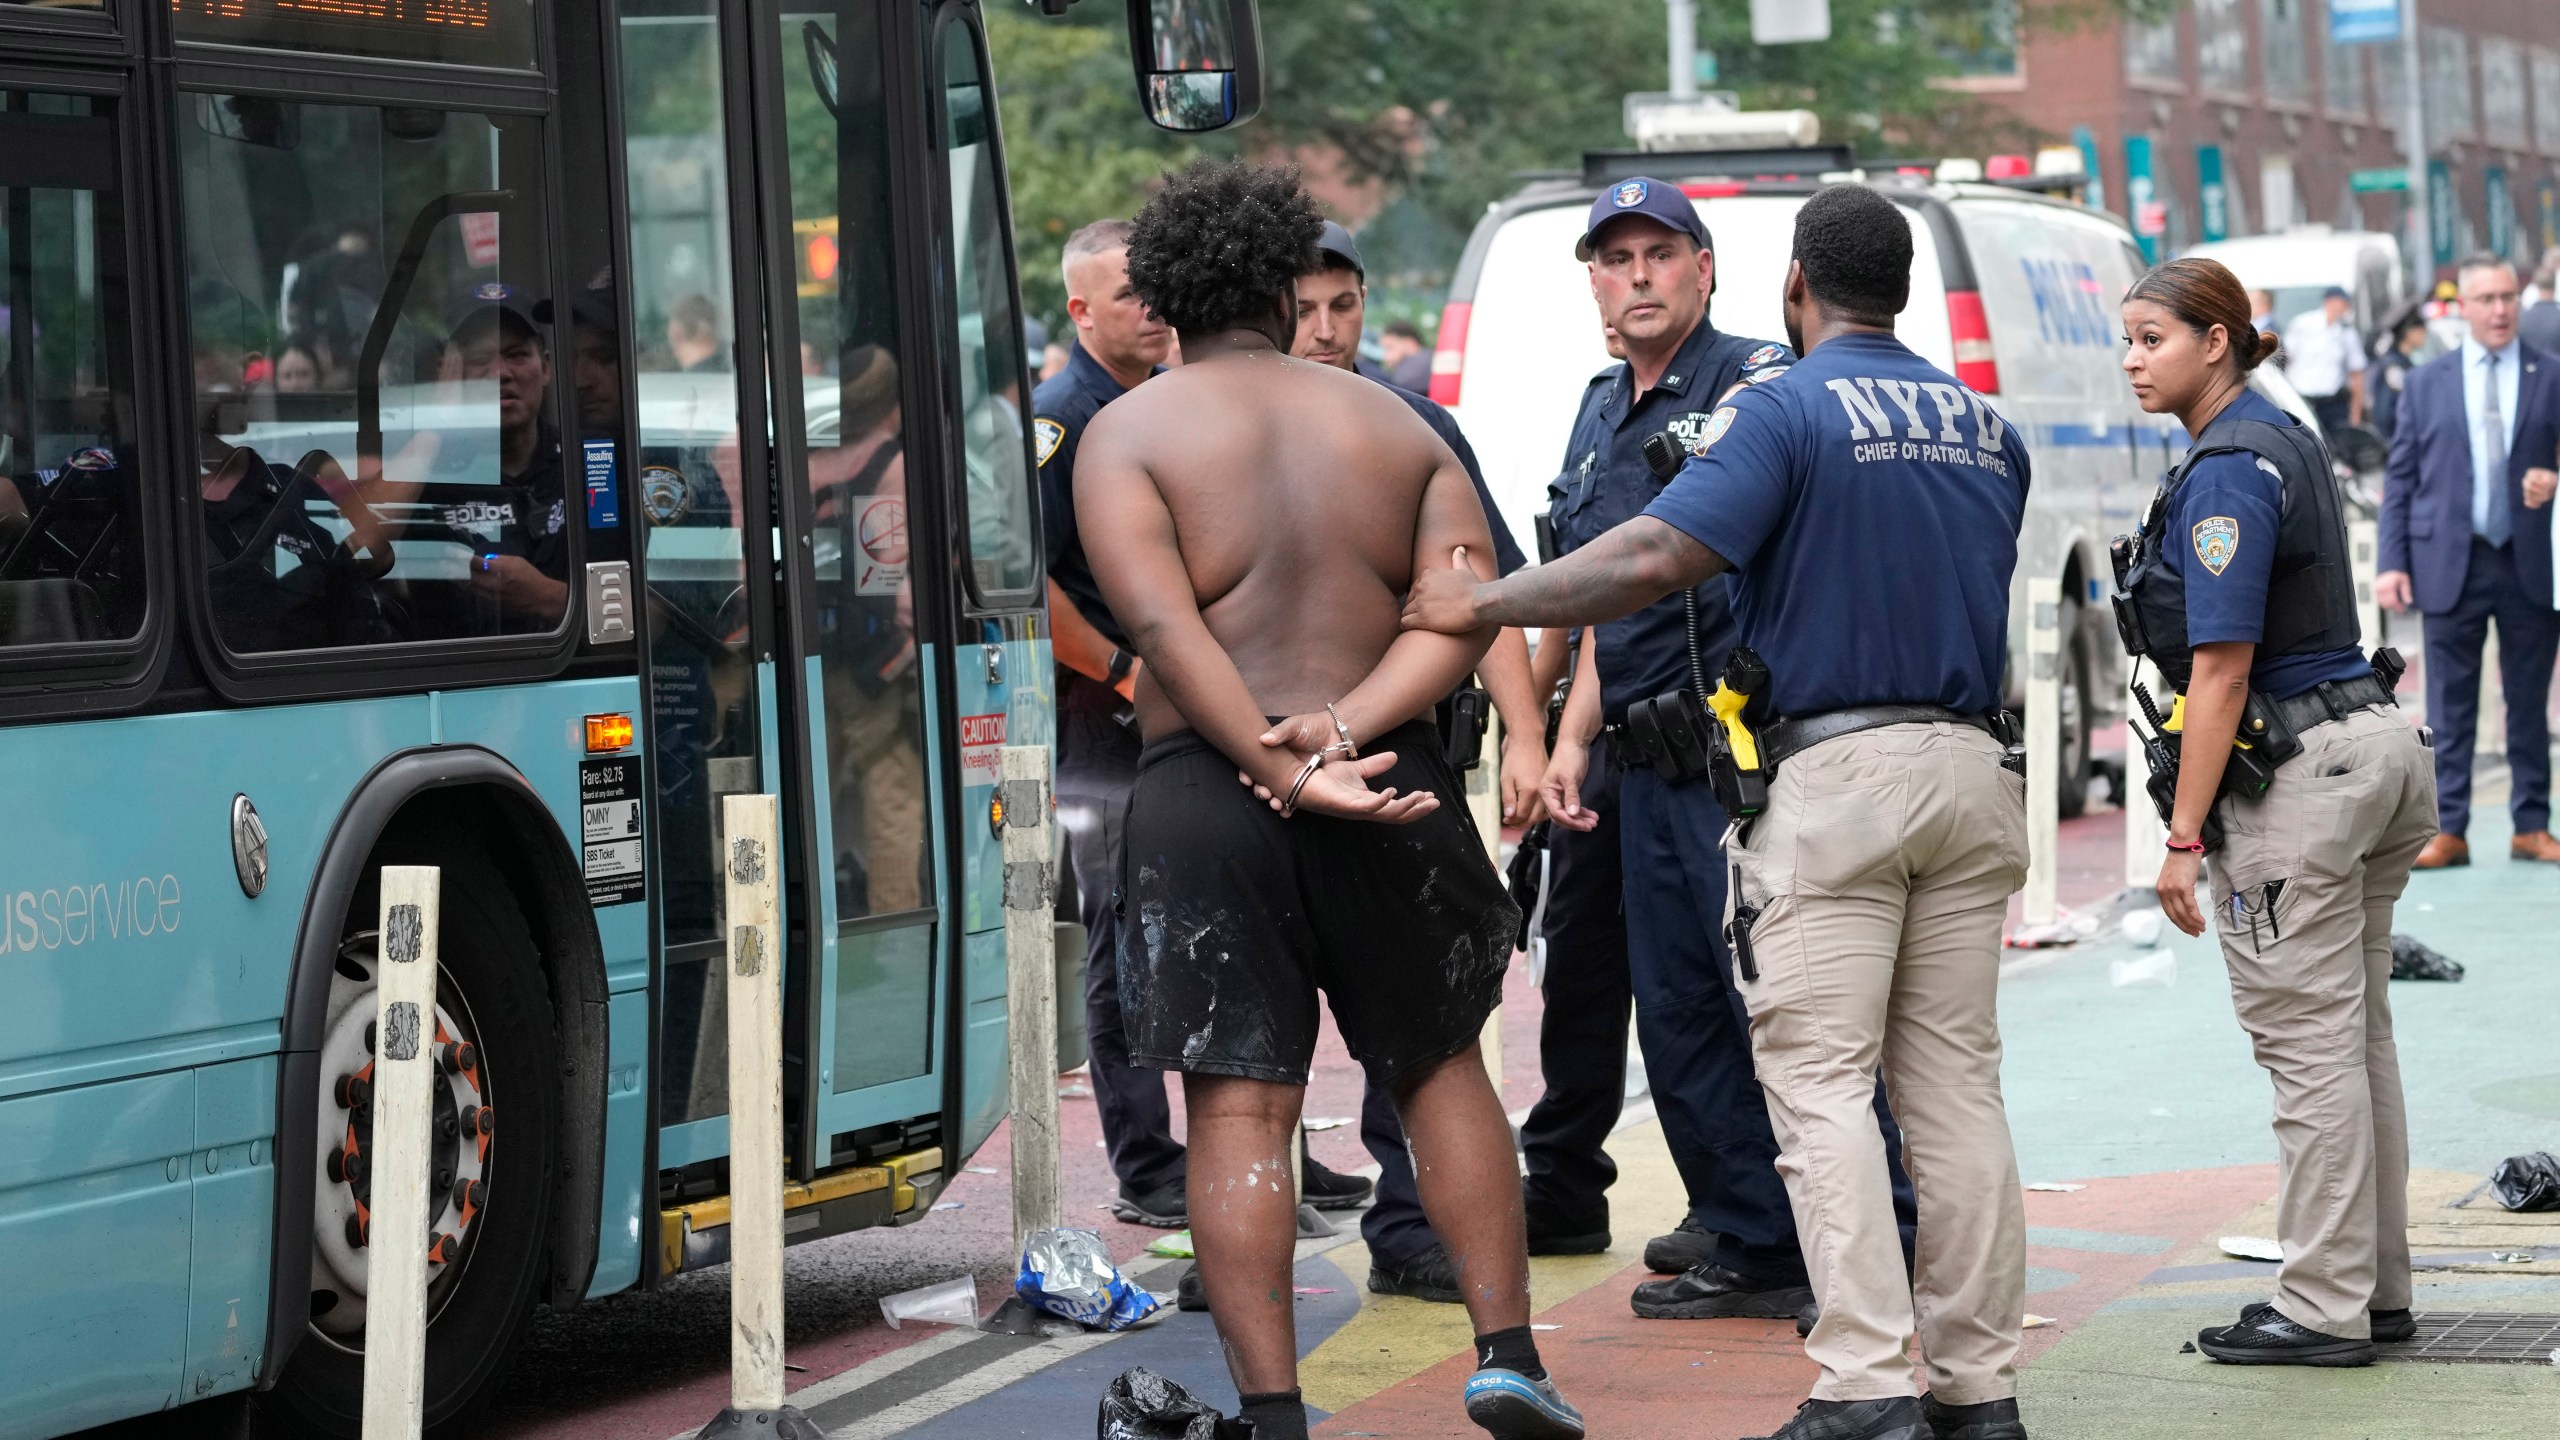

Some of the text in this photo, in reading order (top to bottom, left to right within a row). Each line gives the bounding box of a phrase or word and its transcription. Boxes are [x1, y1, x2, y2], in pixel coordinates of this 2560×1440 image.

[1621, 183, 1641, 192] NYPD
[2020, 257, 2113, 347] POLICE
[1667, 375, 1681, 385] S1
[1688, 412, 1711, 422] NYPD
[1825, 377, 2004, 453] NYPD
[1667, 420, 1707, 439] POLI
[587, 450, 613, 463] Assaulting
[1854, 441, 2008, 478] CHIEF OF PATROL OFFICE
[2202, 520, 2225, 530] POLICE
[2196, 526, 2235, 542] DEPARTMENT
[652, 666, 690, 677] RNING
[962, 717, 1005, 744] CAUTION
[963, 750, 993, 770] Kneeling
[582, 766, 624, 786] Fare: $2.75
[583, 791, 595, 800] Board
[586, 807, 610, 826] OMNY
[586, 848, 615, 862] SBS Ticket
[1470, 1377, 1502, 1387] crocs
